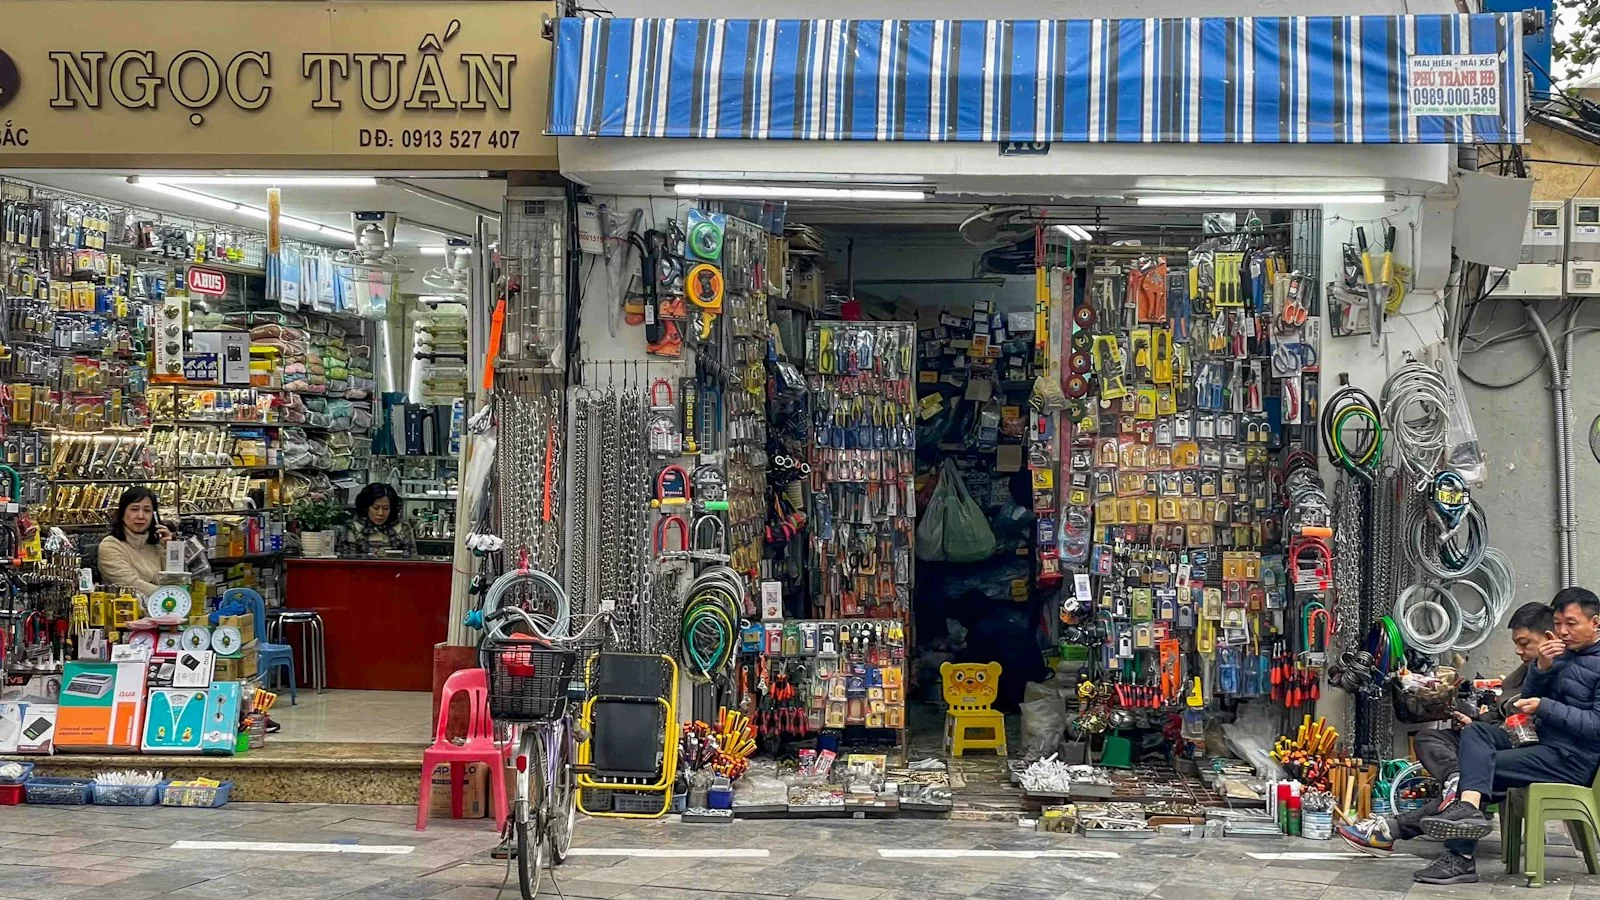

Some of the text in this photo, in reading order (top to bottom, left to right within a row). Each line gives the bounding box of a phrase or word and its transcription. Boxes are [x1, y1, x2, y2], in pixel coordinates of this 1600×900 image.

[49, 19, 517, 126] NGỌC TUẤN
[1413, 87, 1497, 105] 0989.000.589
[0, 119, 29, 146] ẮC
[402, 129, 443, 148] 0913
[450, 130, 482, 149] 527
[488, 130, 520, 149] 407
[193, 272, 221, 290] ABUS
[433, 766, 477, 776] APO
